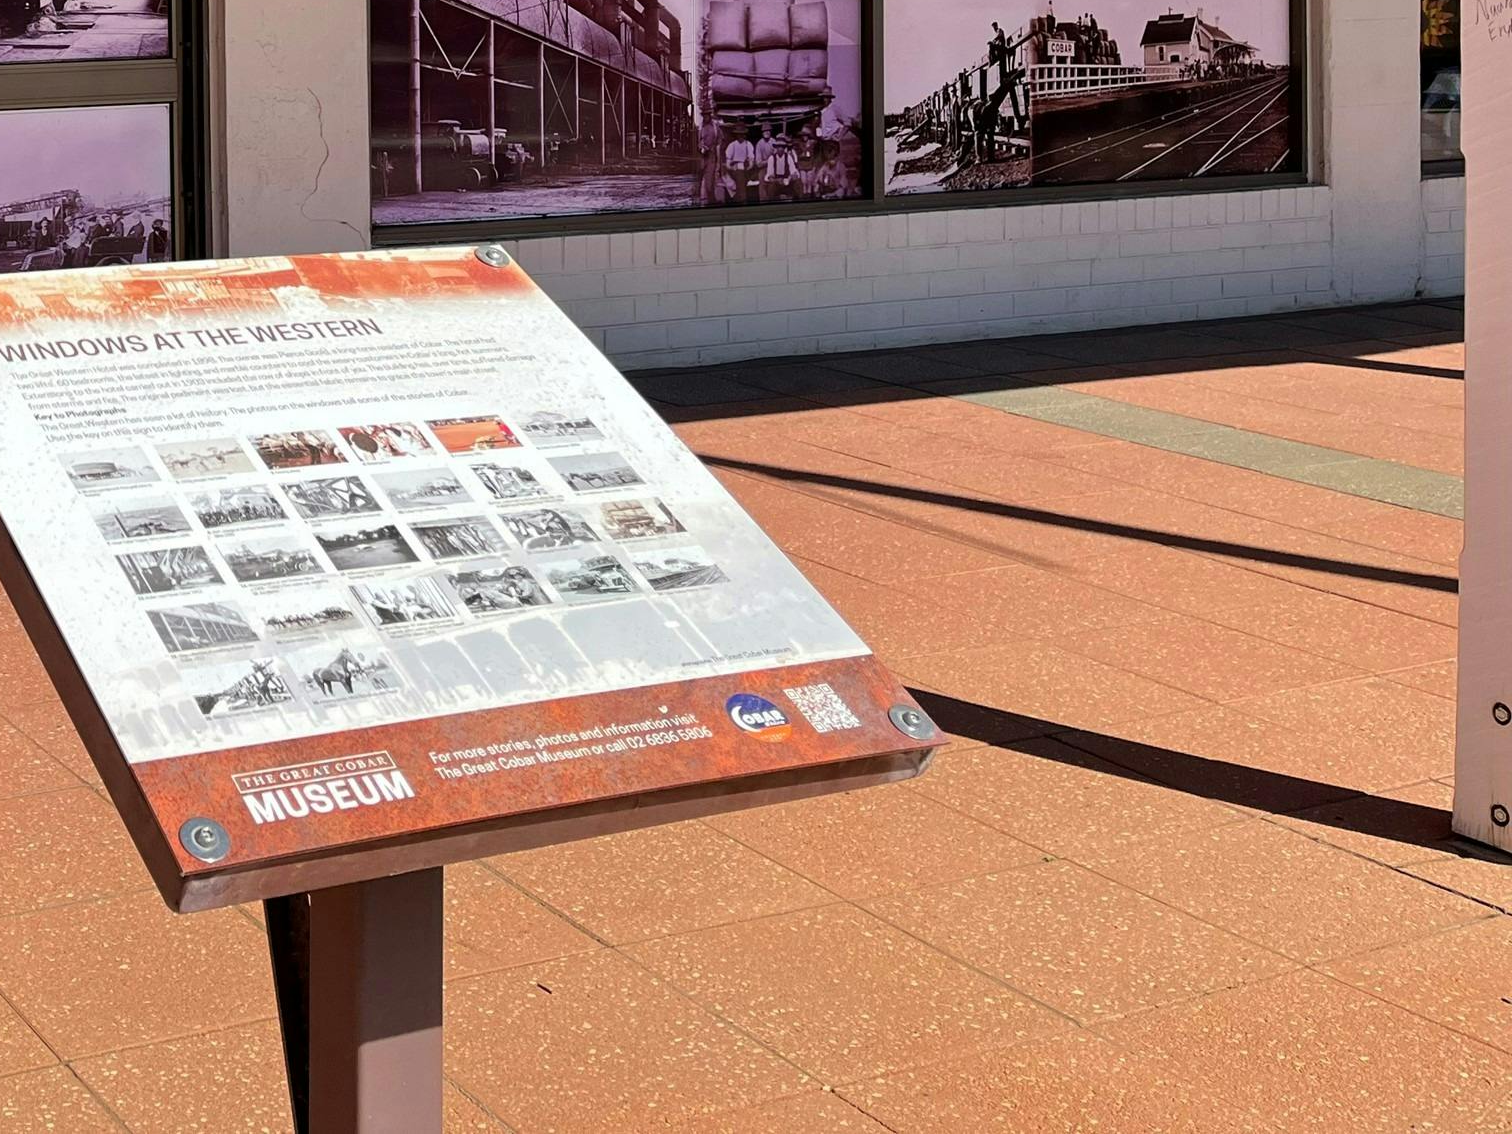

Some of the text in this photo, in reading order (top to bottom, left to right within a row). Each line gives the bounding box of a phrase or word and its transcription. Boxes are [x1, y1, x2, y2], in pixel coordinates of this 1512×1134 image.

[153, 331, 185, 351] AT
[187, 327, 248, 347] THE
[245, 318, 383, 343] WESTERN
[428, 713, 699, 764] For more stories, photos and information visit
[731, 705, 785, 733] COBAR
[240, 756, 388, 788] THE GREAT COBAR
[434, 725, 713, 779] The Great Cobar Museum or call 02 6836 5806
[243, 770, 415, 824] MUSEUM
